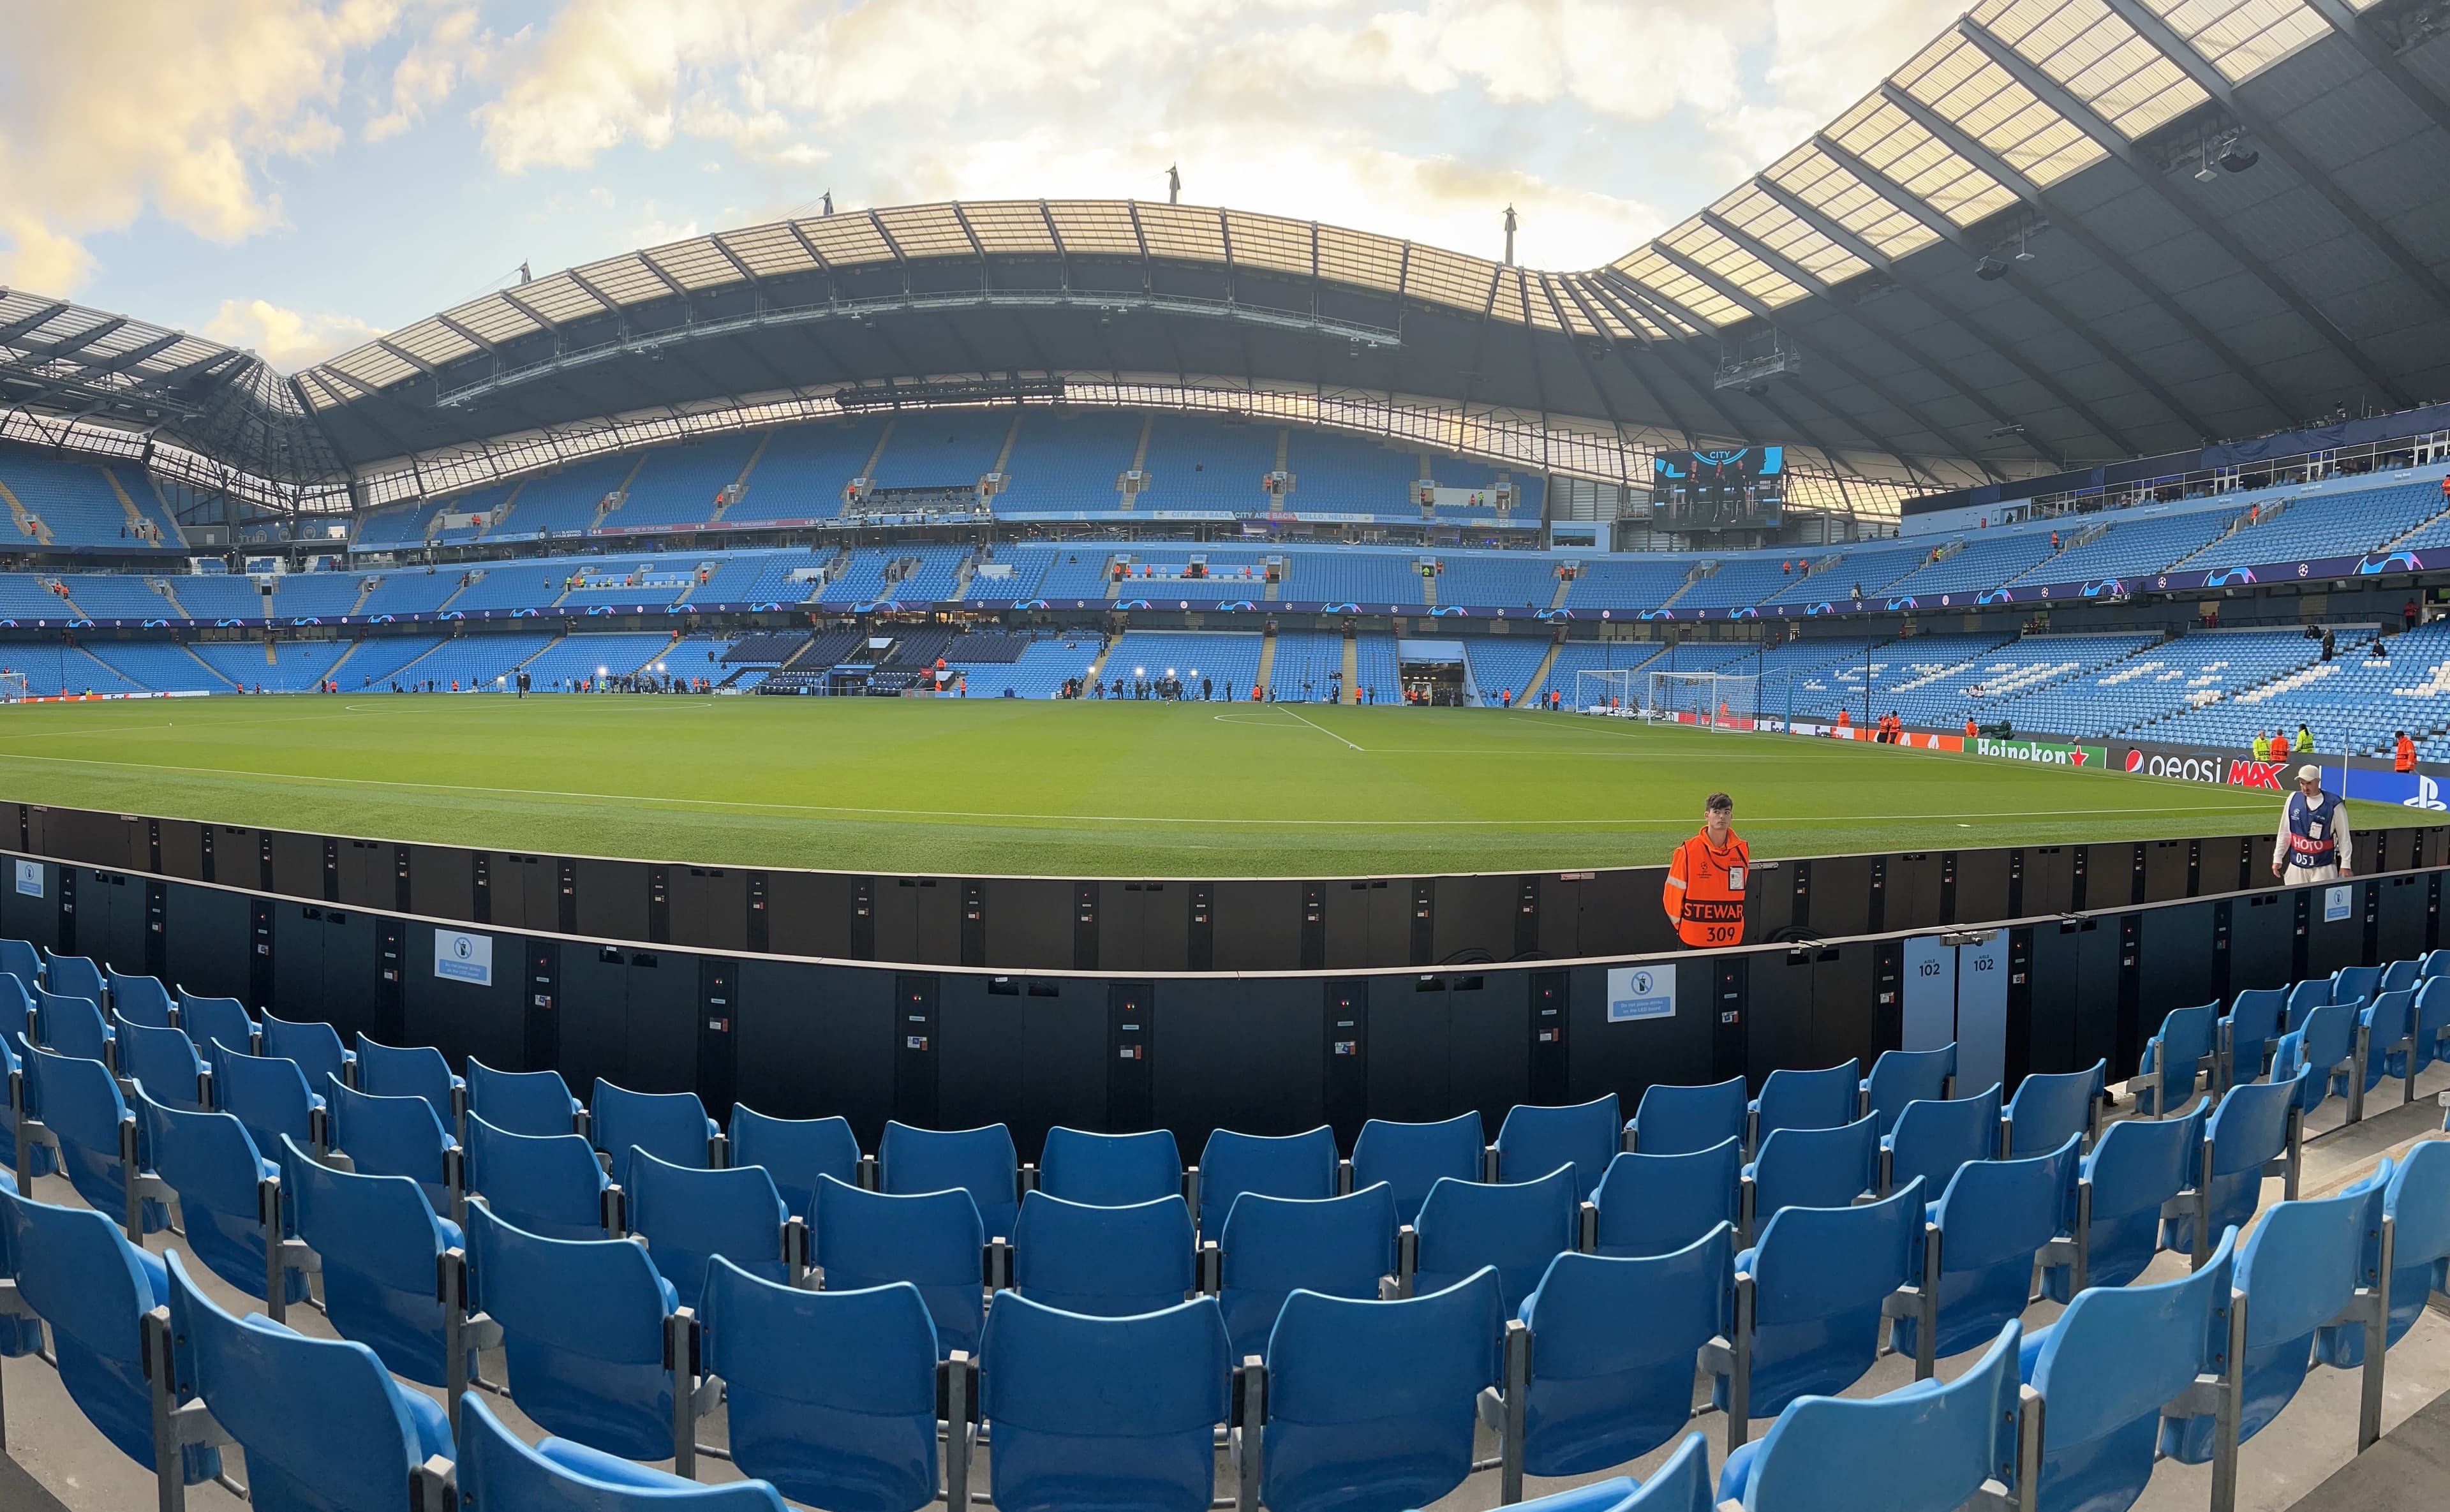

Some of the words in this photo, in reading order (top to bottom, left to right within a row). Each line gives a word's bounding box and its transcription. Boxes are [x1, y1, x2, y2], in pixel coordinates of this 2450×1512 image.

[1709, 450, 1730, 459] CITY
[2227, 759, 2290, 790] MAX
[2296, 852, 2315, 866] 051
[1684, 903, 1744, 919] STEWAR
[1707, 927, 1735, 942] 309
[1919, 963, 1940, 977] 102
[1974, 958, 1994, 972] 102
